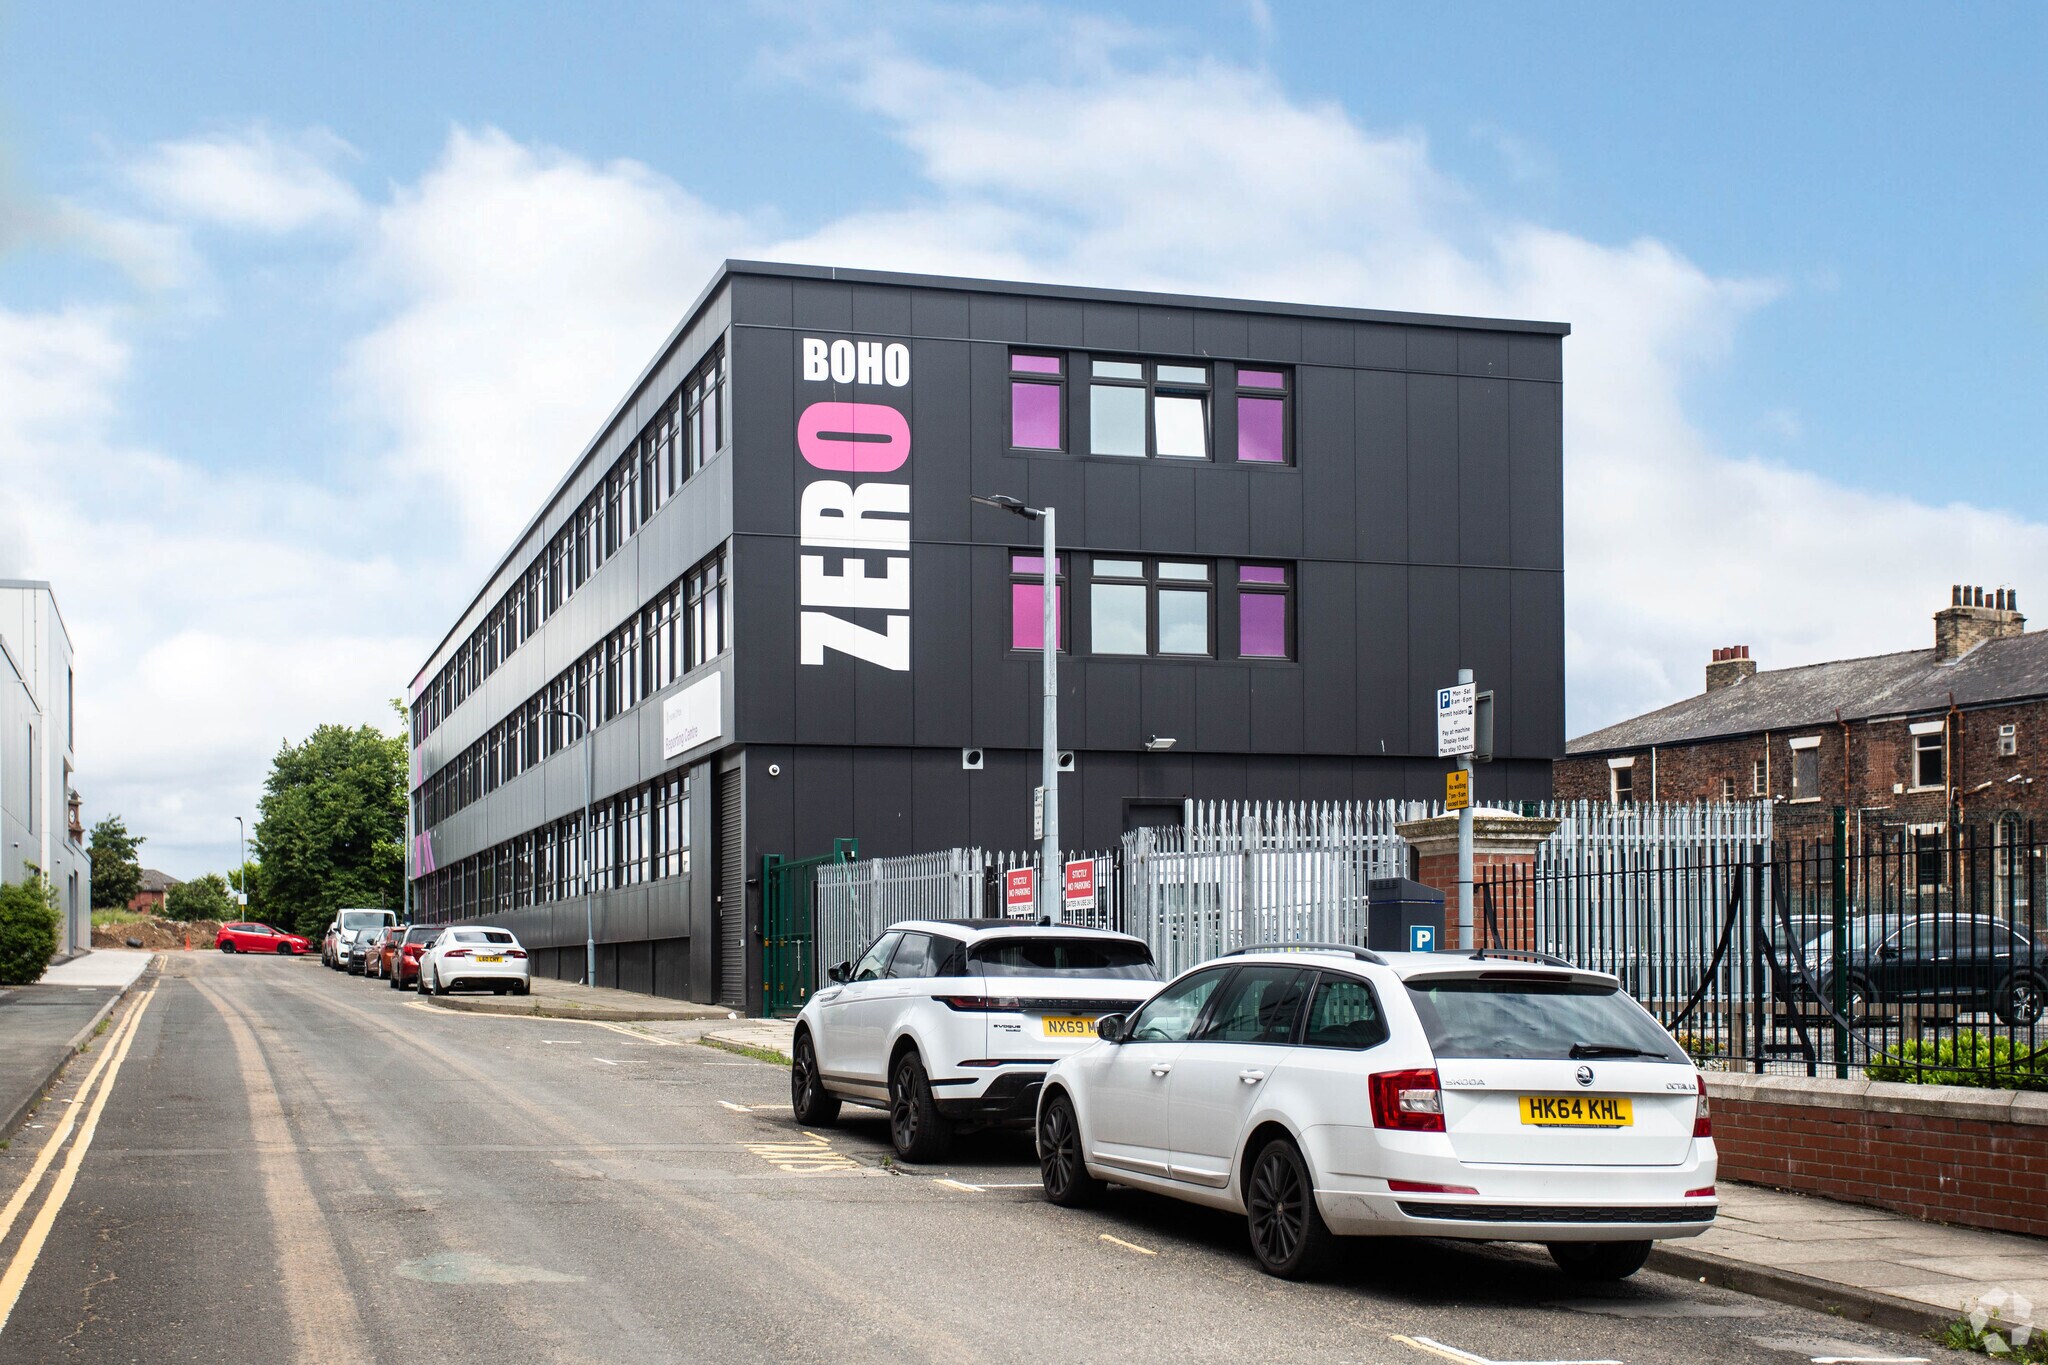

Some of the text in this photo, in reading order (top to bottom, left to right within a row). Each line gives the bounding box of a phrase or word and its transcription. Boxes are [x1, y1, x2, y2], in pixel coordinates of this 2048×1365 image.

[803, 337, 910, 388] BOHO
[797, 401, 911, 672] ZERO
[1442, 692, 1449, 708] P
[1015, 888, 1030, 896] PARKING
[1074, 881, 1091, 890] PARKING
[1416, 930, 1431, 948] P
[1049, 1021, 1084, 1033] NX69
[1530, 1098, 1626, 1120] HK64 KHL
